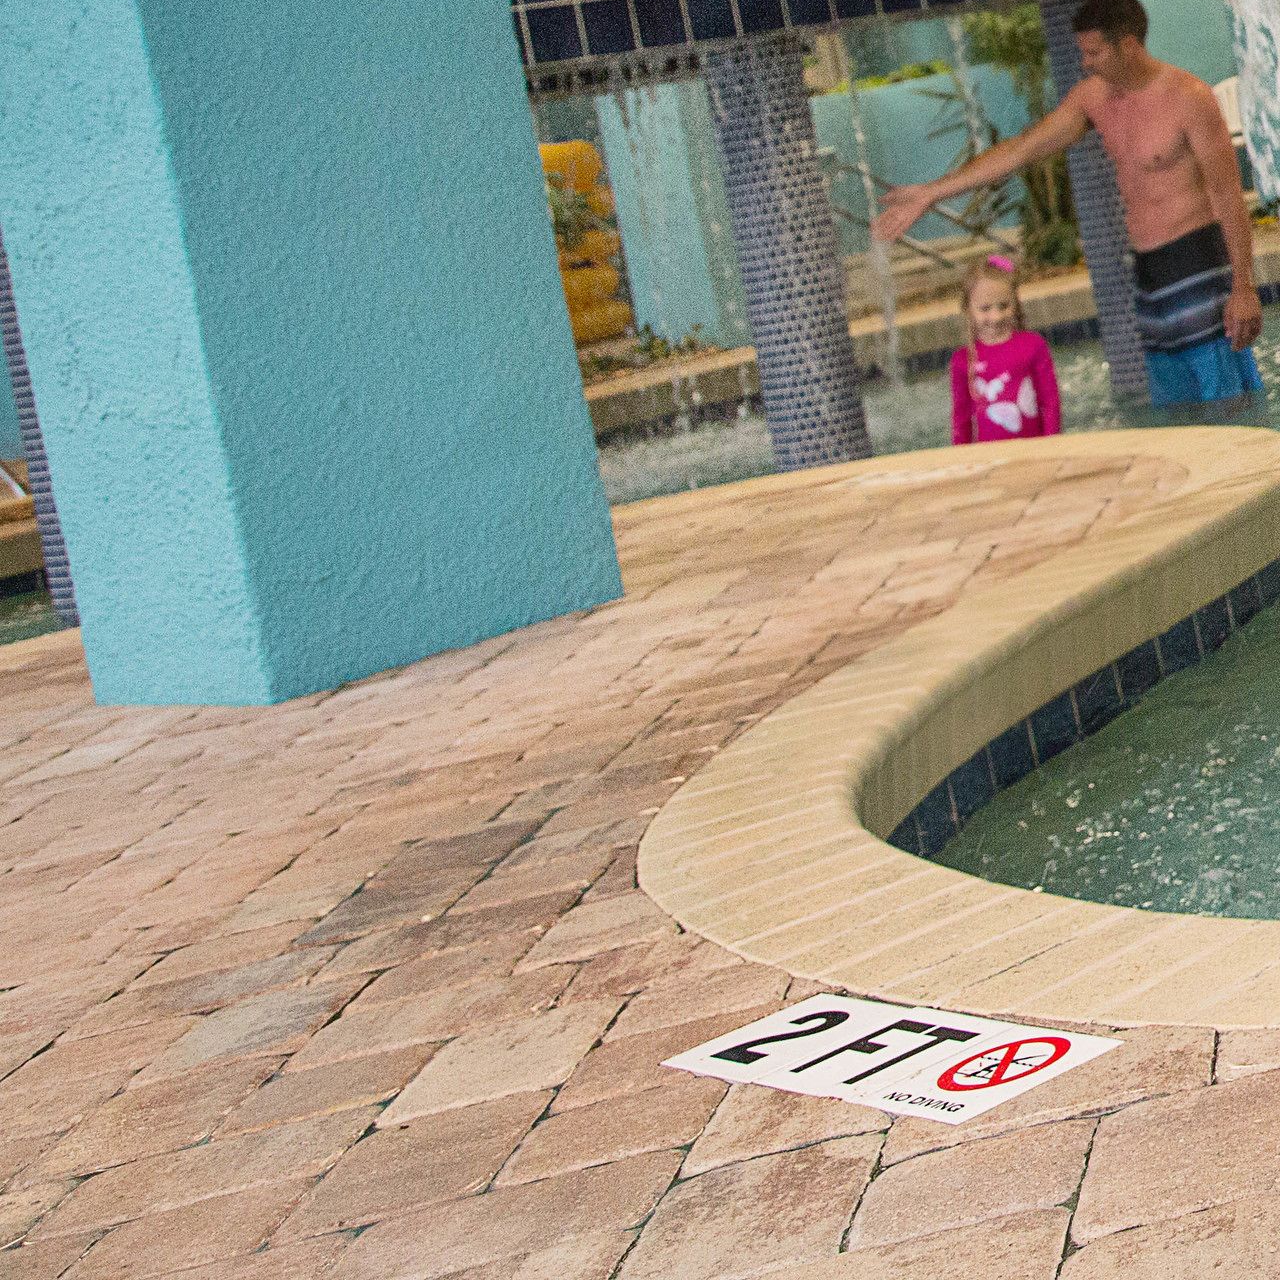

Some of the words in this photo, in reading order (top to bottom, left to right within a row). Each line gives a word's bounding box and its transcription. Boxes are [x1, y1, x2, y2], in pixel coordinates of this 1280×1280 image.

[710, 1010, 850, 1064] 2
[789, 1019, 981, 1085] FT
[883, 1091, 912, 1102] NO
[908, 1096, 965, 1112] DIVING
